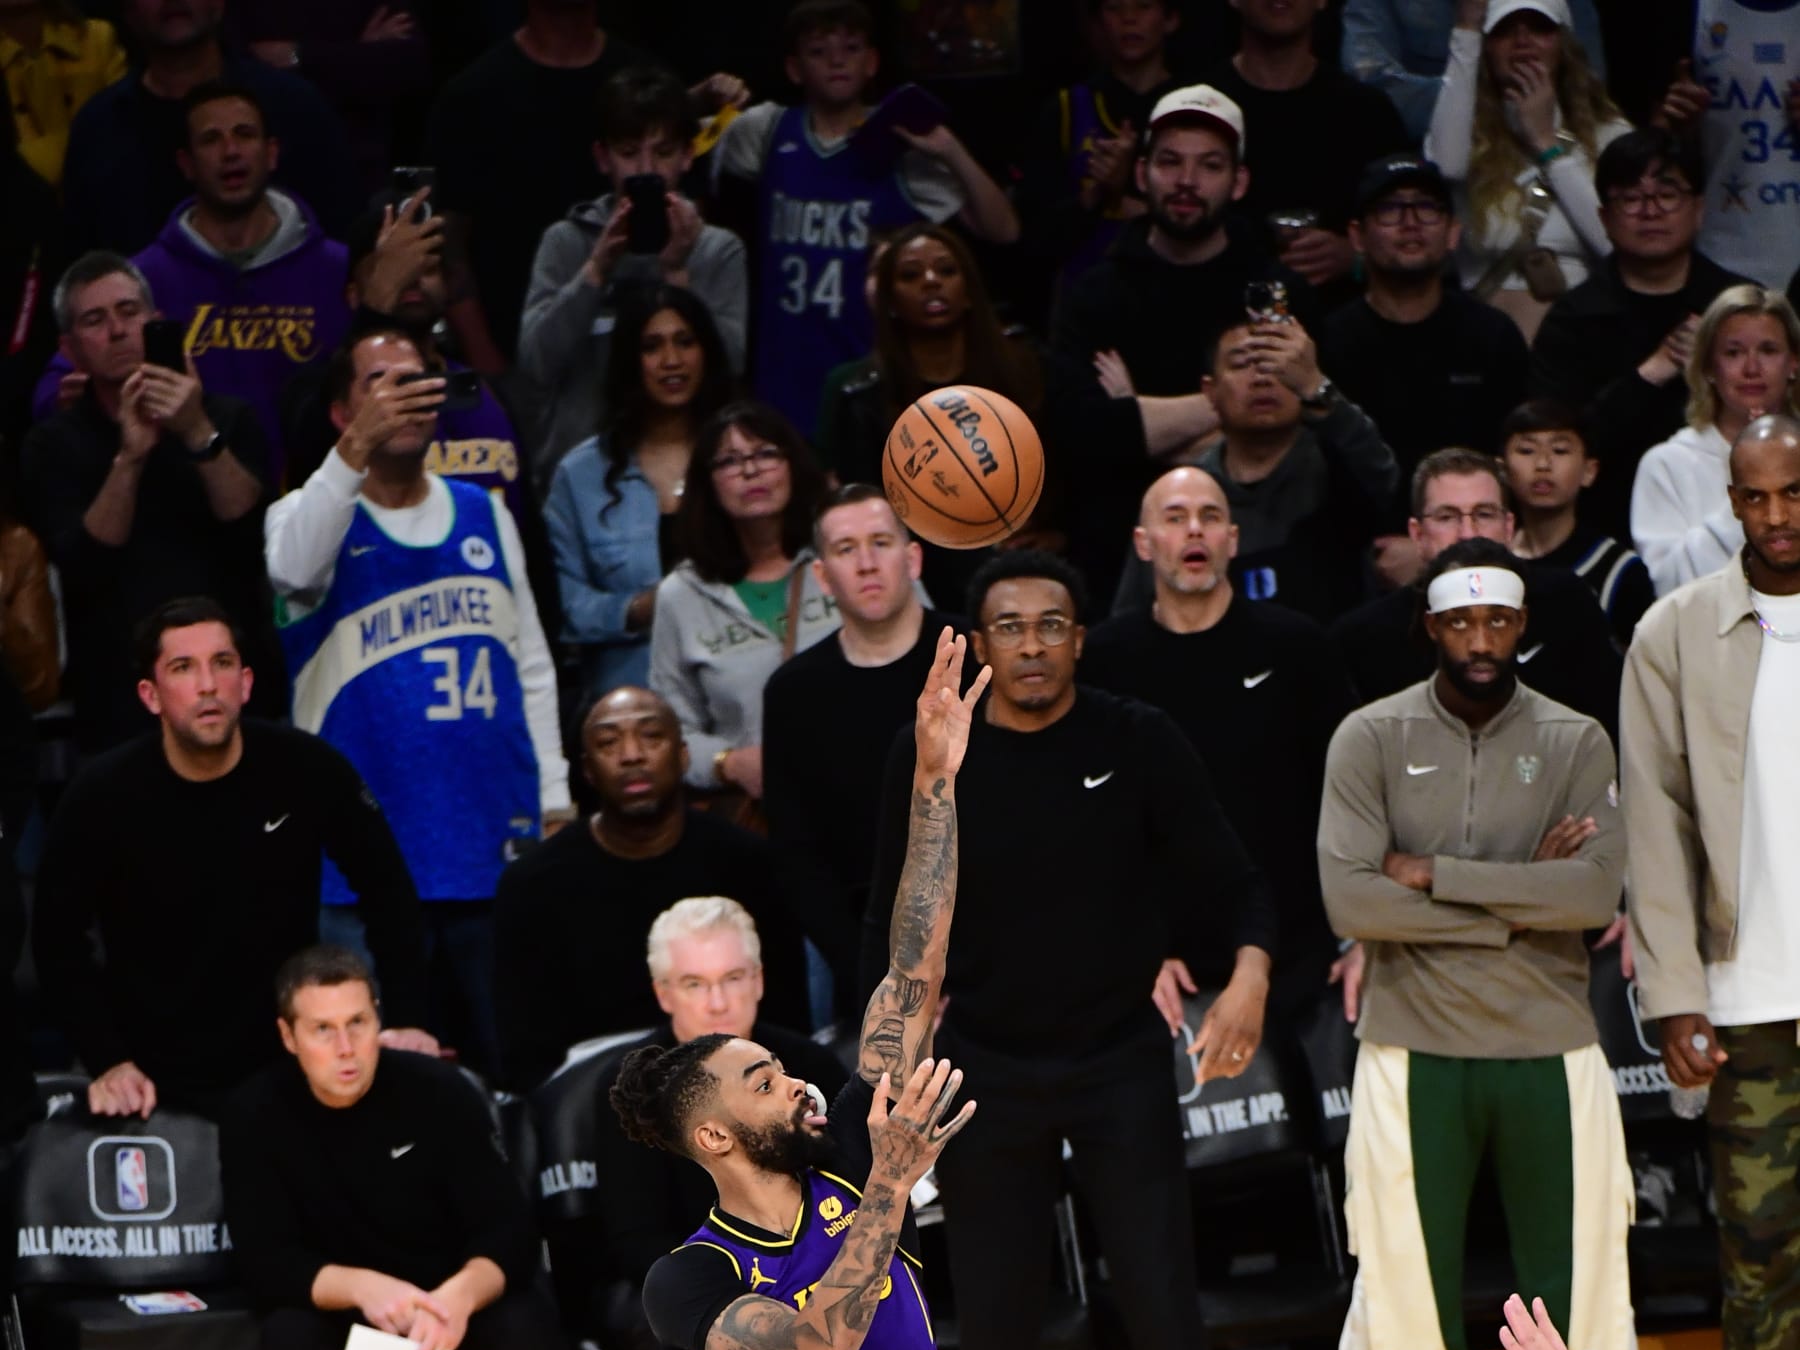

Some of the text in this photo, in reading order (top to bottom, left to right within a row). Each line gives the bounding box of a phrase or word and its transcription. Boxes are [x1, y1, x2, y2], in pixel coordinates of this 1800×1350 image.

[771, 192, 872, 249] BUCKS
[780, 255, 844, 318] 34
[183, 304, 320, 363] LAKERS
[424, 438, 518, 481] AKERS
[934, 389, 999, 478] Wilson
[360, 585, 494, 660] MILWAUKEE
[421, 646, 497, 721] 34
[1211, 1098, 1249, 1134] THE
[1250, 1091, 1289, 1127] APP.
[18, 1226, 50, 1257] ALL
[52, 1226, 123, 1257] ACCESS.
[124, 1226, 157, 1257] ALL
[159, 1226, 181, 1256] IN
[182, 1223, 218, 1254] THE
